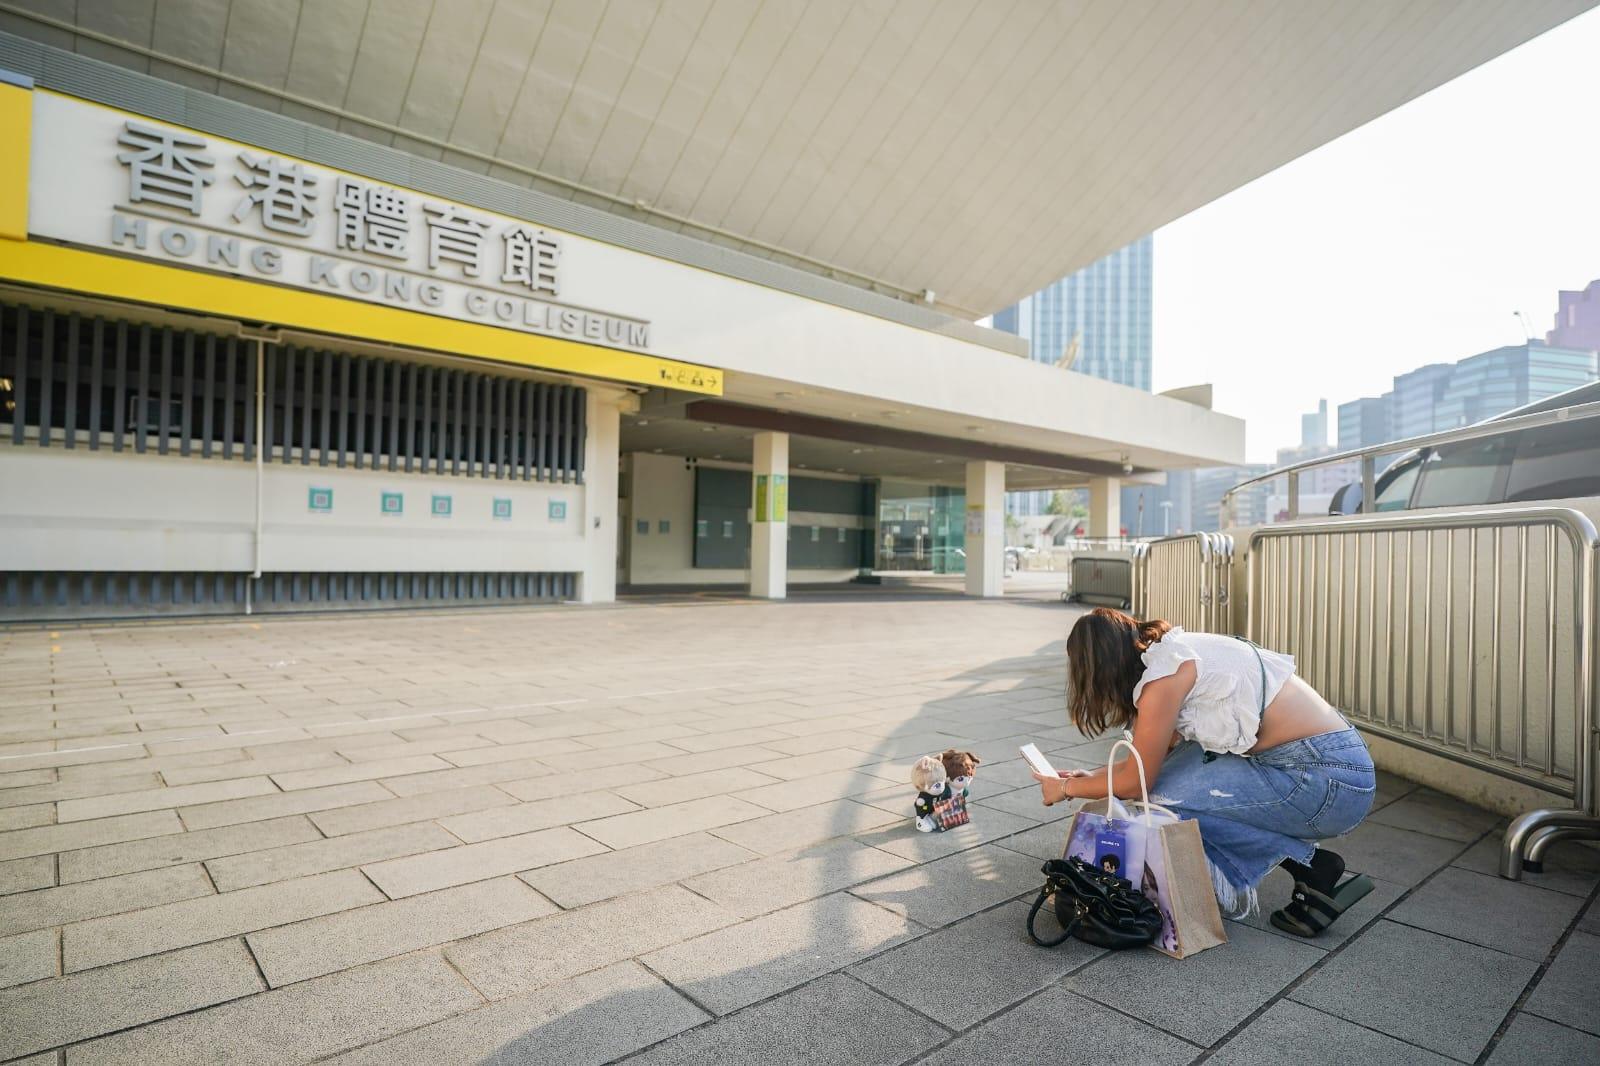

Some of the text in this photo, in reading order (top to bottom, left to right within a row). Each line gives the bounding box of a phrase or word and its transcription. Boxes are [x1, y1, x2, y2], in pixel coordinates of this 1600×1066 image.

[111, 213, 650, 349] HONG KONG COLISEUM
[116, 120, 563, 296] 香港體育館
